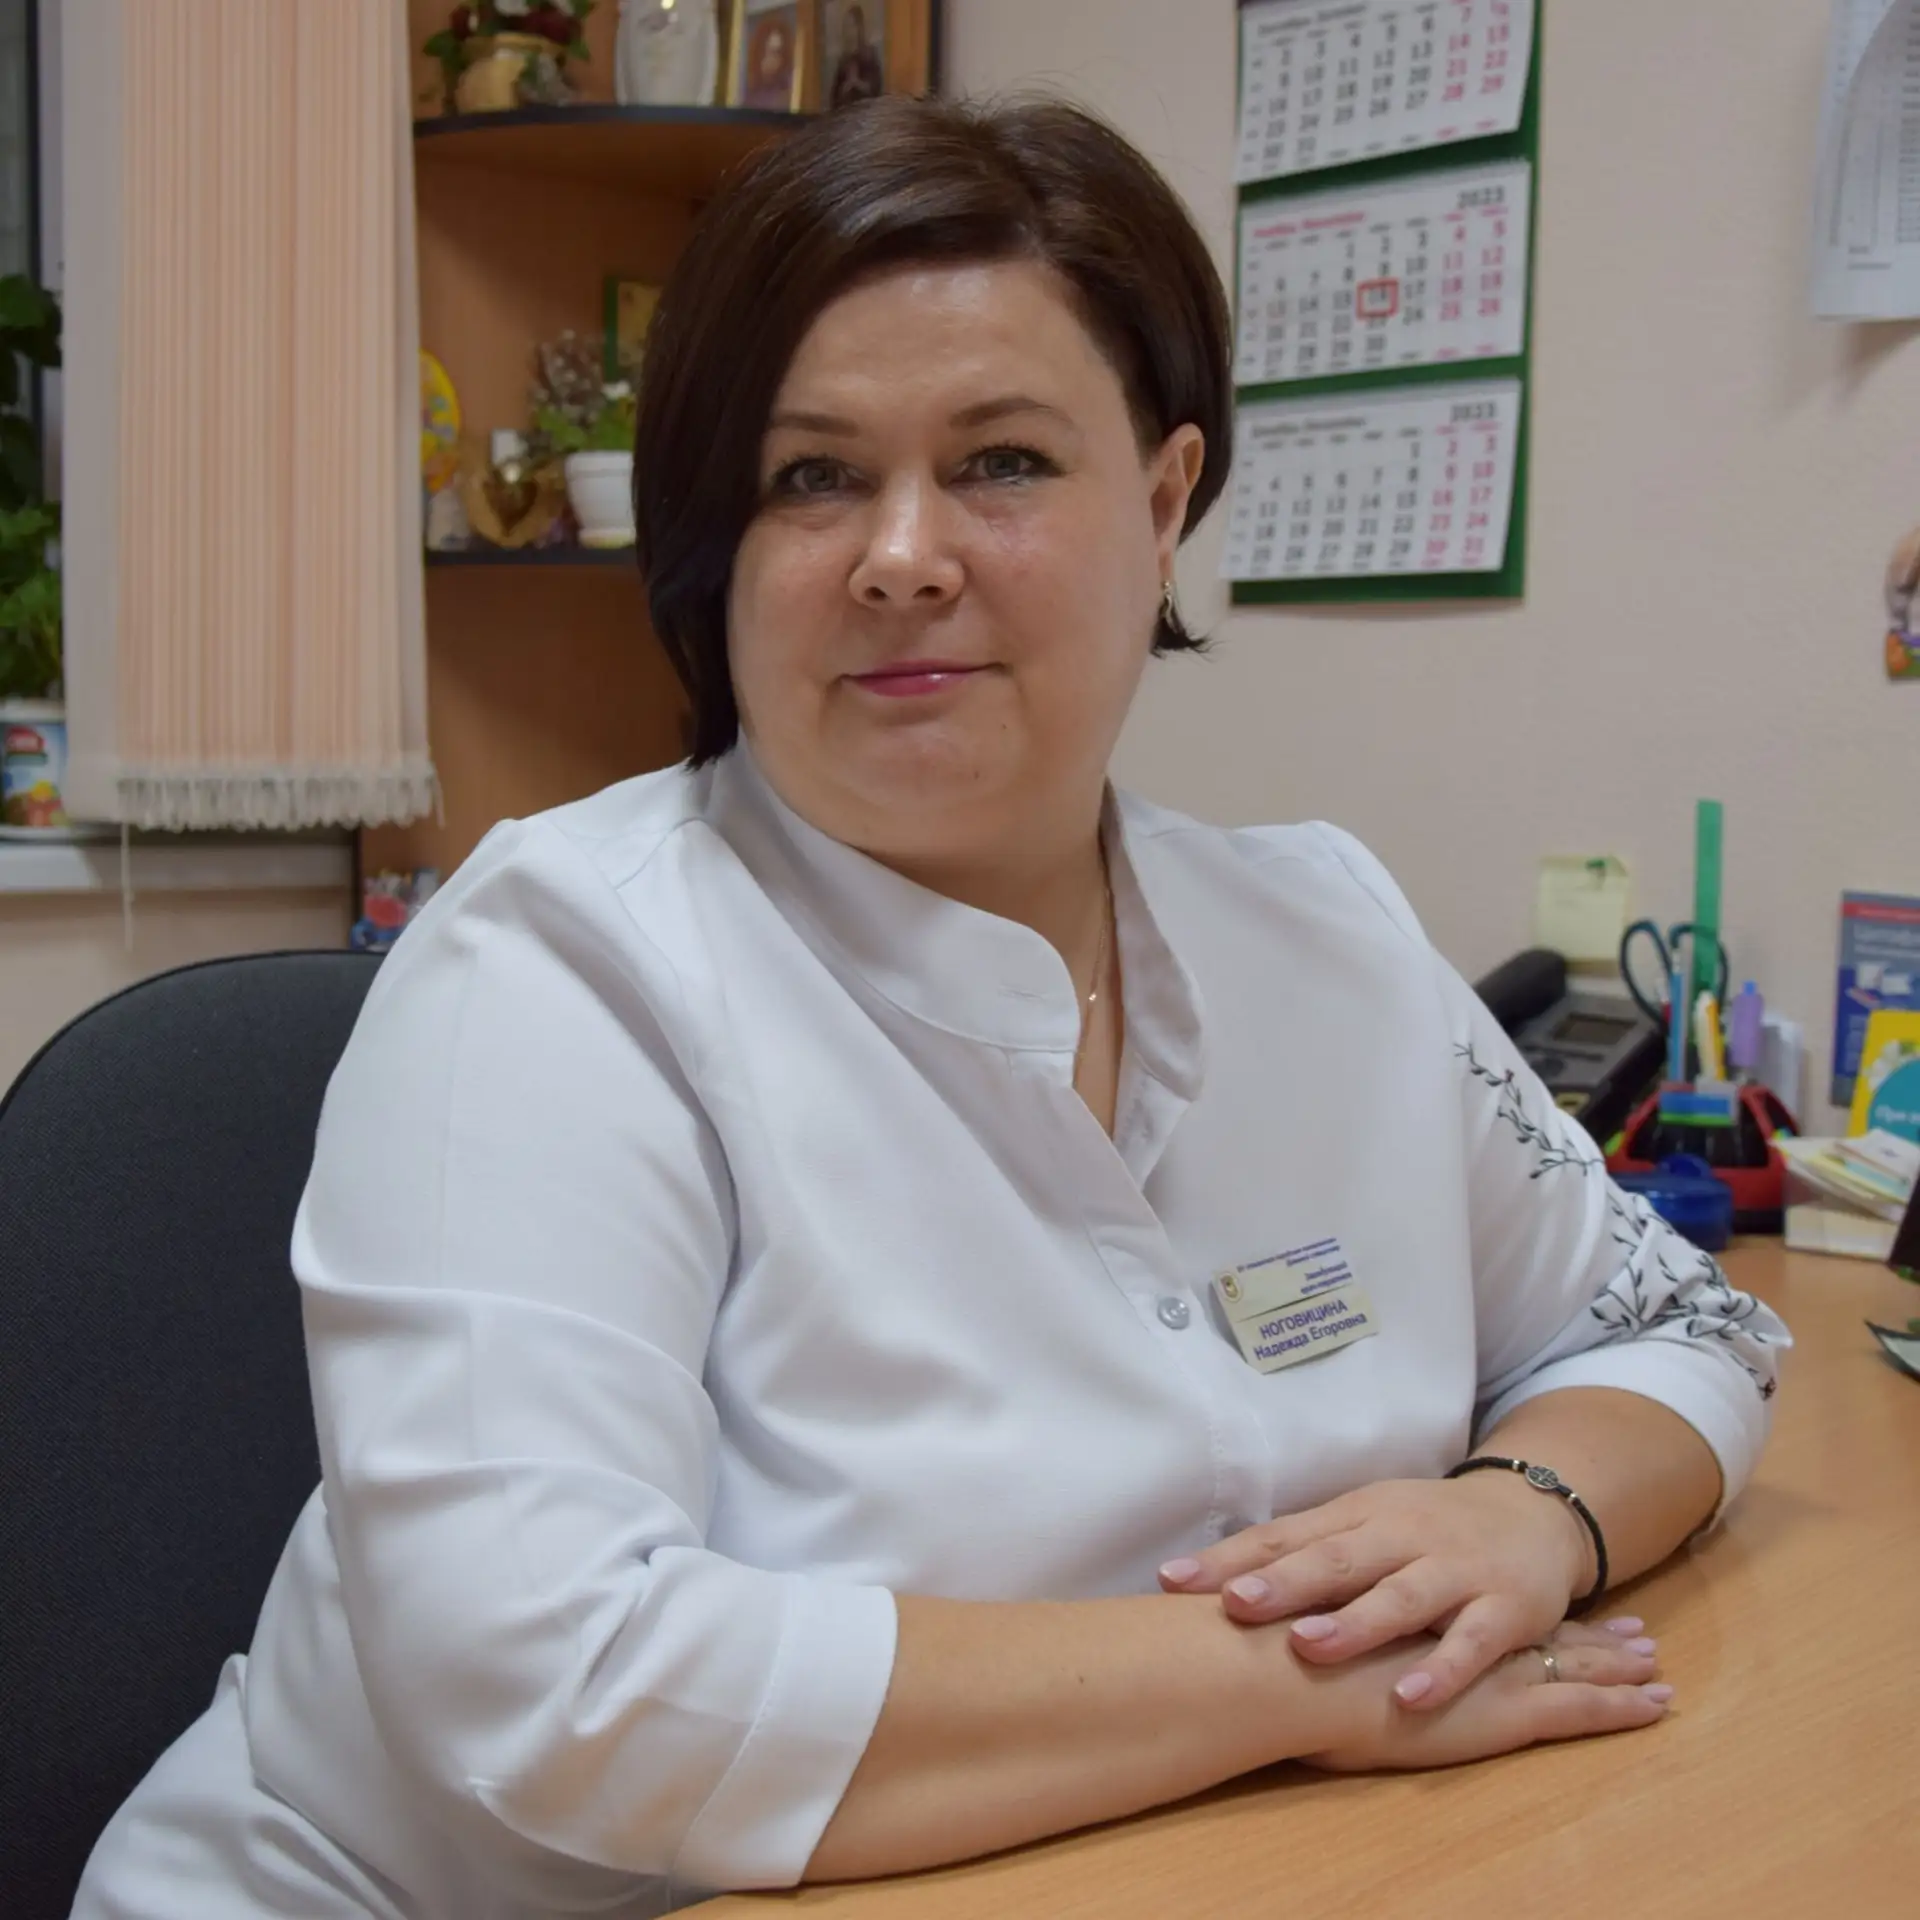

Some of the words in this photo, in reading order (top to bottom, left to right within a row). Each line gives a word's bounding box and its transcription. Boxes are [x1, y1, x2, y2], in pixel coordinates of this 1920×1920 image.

[1253, 1333, 1310, 1361] Надежда
[1309, 1313, 1368, 1340] Егоровна
[1259, 1299, 1348, 1340] НОГОВИЦИНА
